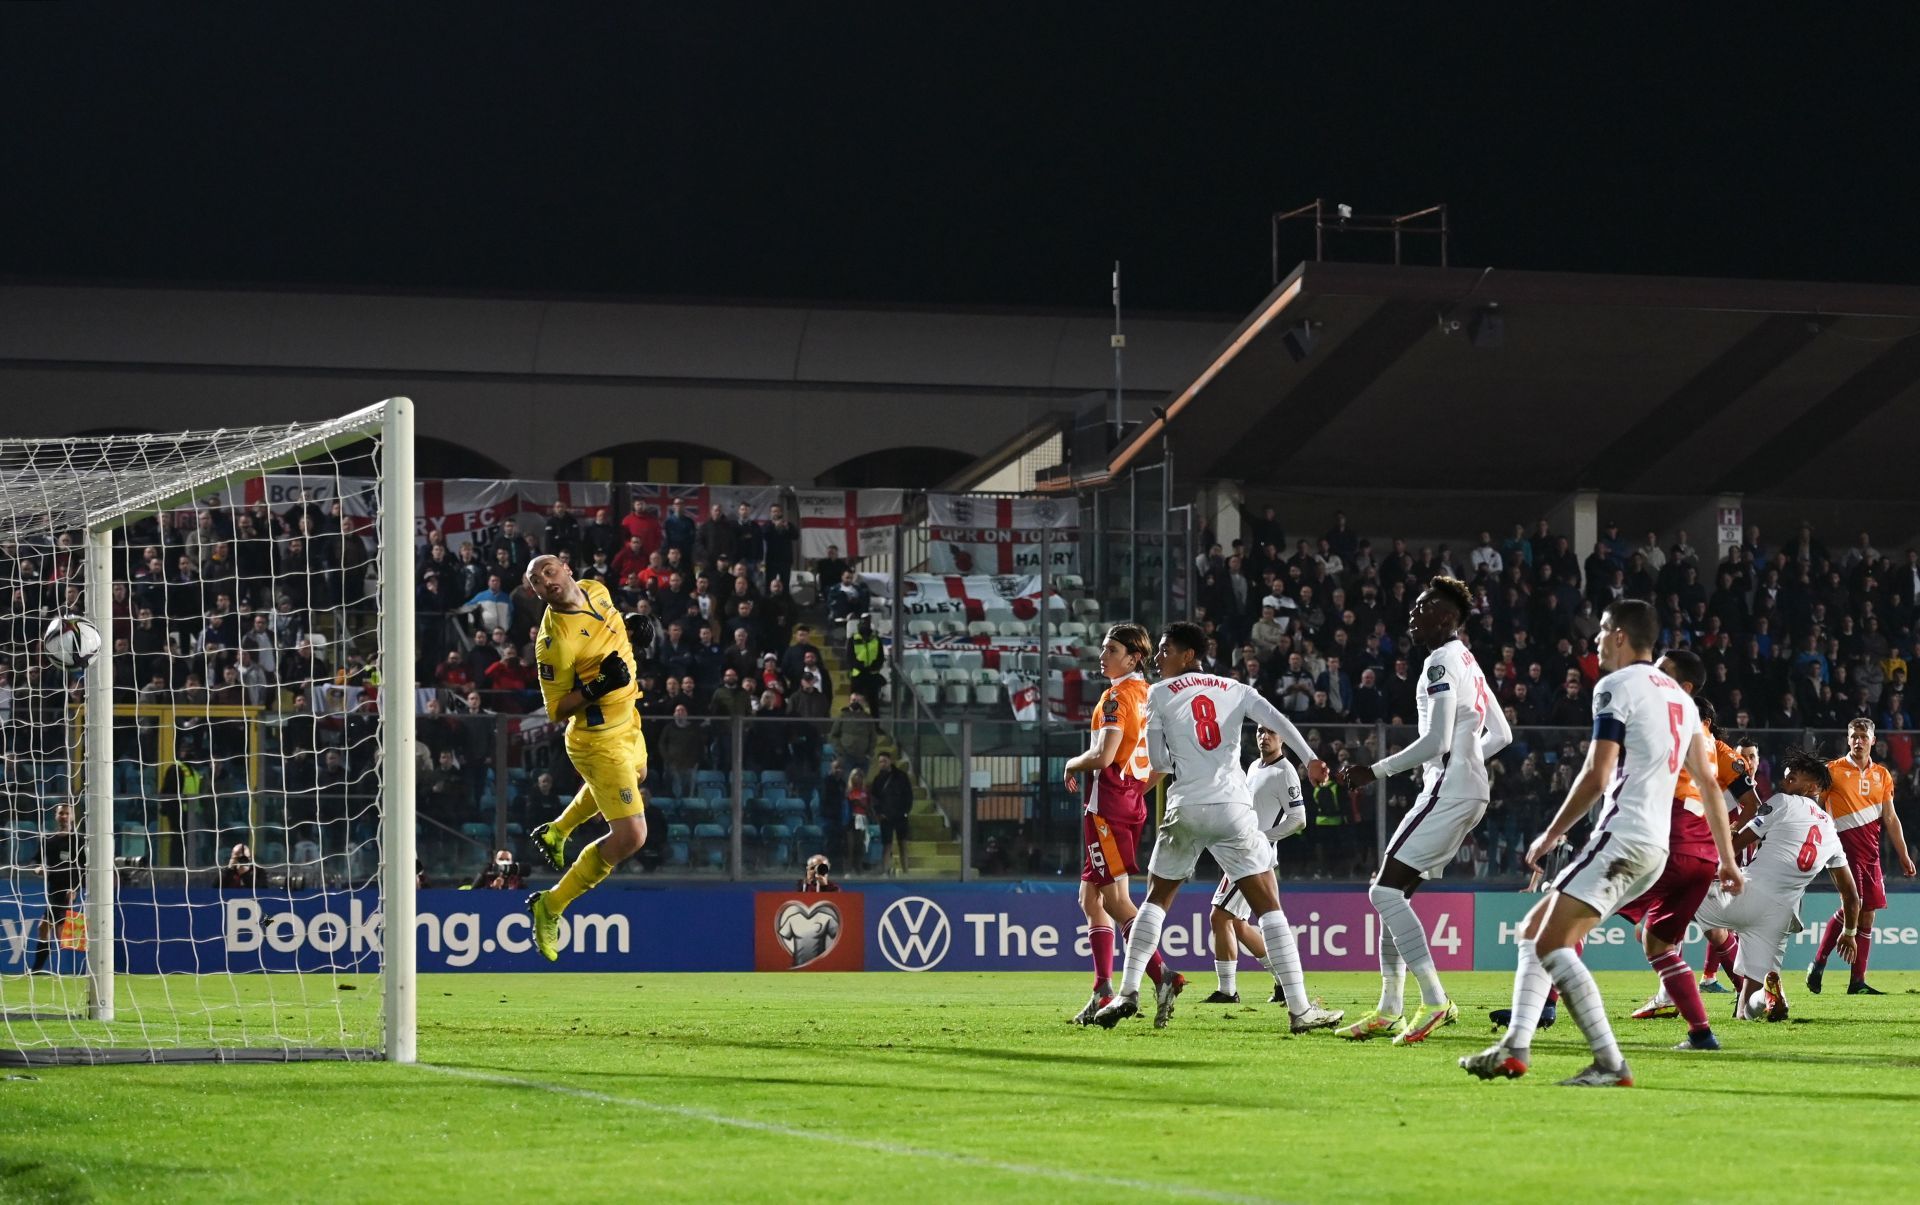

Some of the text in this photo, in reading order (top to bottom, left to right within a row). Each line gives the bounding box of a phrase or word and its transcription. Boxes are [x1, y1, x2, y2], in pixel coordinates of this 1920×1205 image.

[463, 508, 496, 531] FC
[984, 530, 1012, 543] ON
[1016, 552, 1074, 567] HARY
[1168, 677, 1229, 695] BELLINGHAM
[1191, 694, 1222, 752] 8
[1667, 701, 1684, 776] 5
[1796, 825, 1823, 873] 6
[227, 898, 630, 967] Bookng.cm
[964, 913, 1058, 957] The
